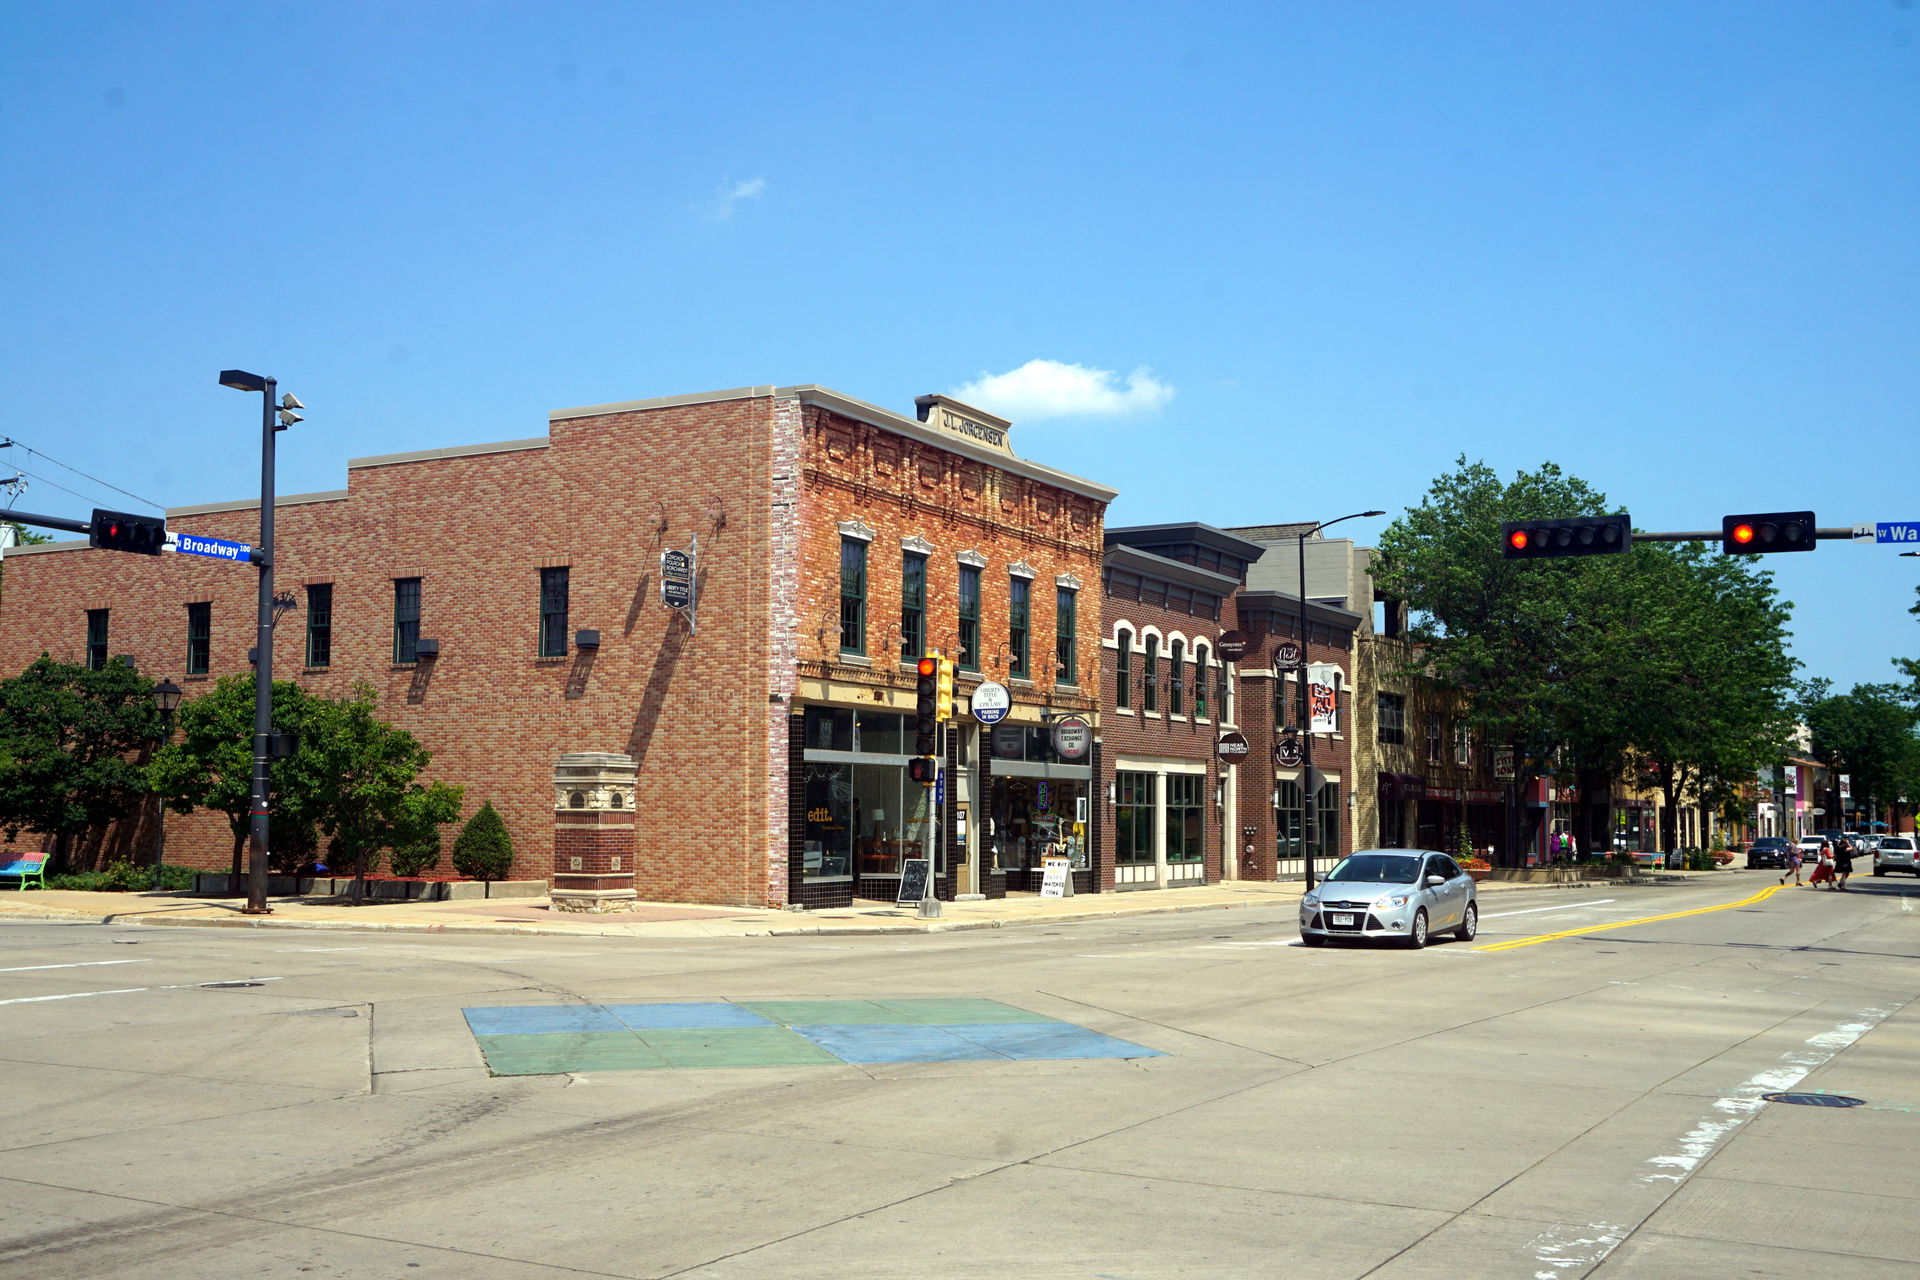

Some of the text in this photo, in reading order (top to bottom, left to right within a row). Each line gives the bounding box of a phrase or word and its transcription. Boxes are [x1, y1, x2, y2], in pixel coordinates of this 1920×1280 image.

[959, 418, 1004, 447] JORGENSEN
[183, 537, 239, 560] Broadway
[240, 545, 251, 553] 100
[807, 807, 832, 822] edit.
